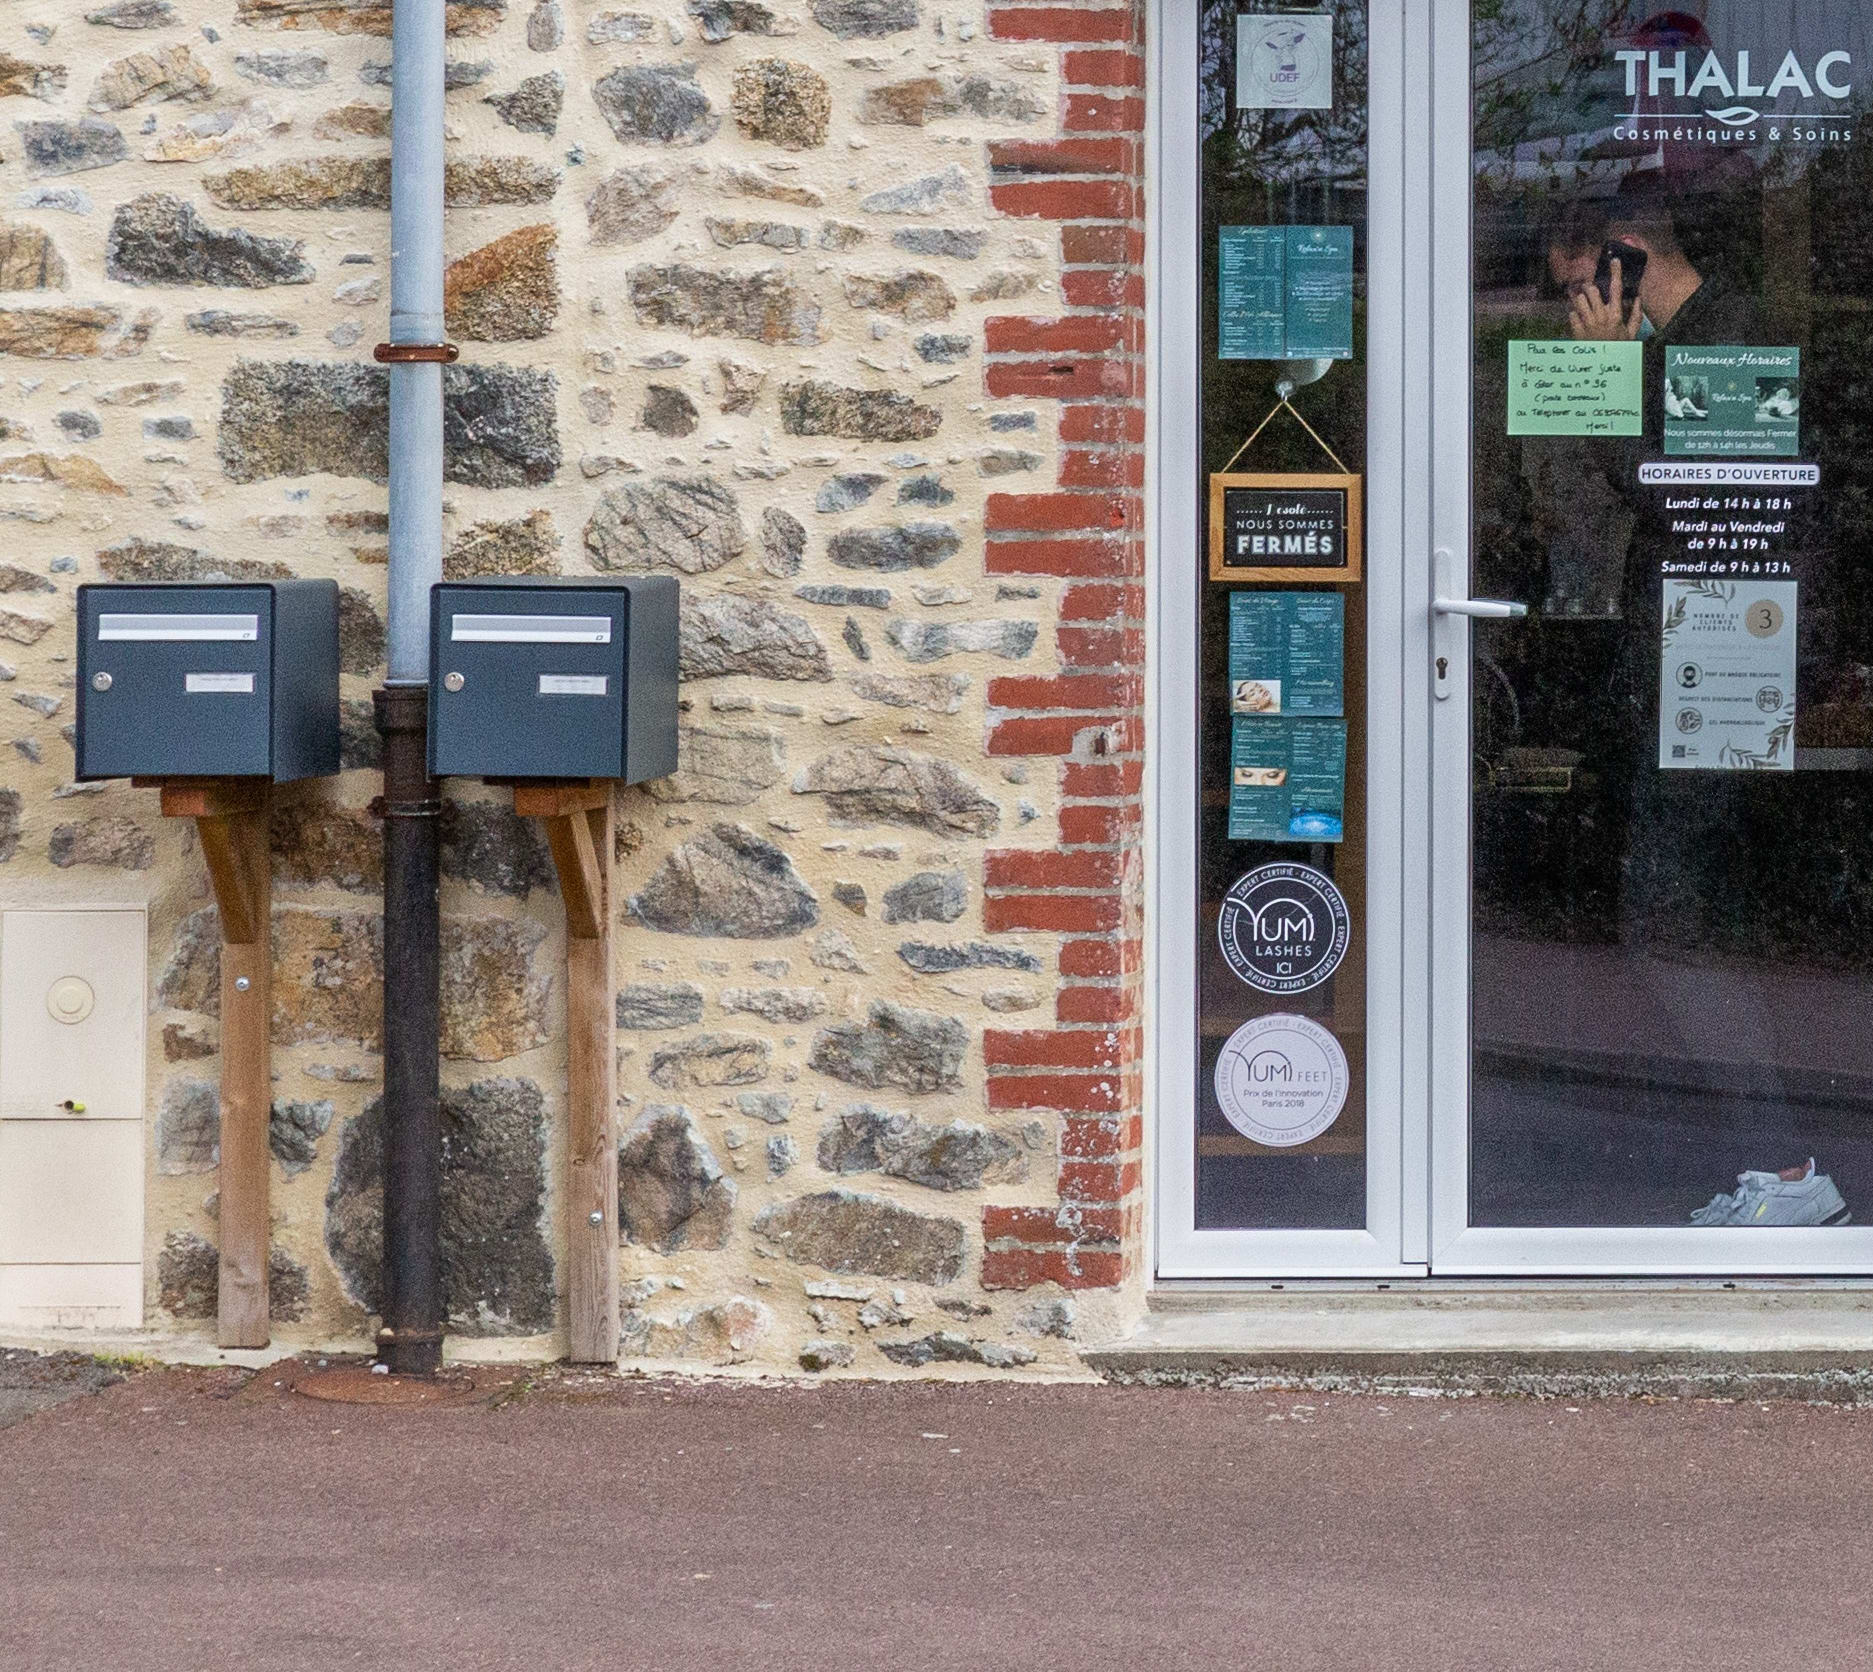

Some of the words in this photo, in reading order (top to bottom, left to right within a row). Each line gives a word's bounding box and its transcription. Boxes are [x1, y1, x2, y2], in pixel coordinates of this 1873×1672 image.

[1270, 72, 1300, 83] UDEF
[1614, 50, 1851, 98] THALAC
[1614, 126, 1757, 145] Cosmétiques
[1769, 128, 1780, 141] &
[1793, 126, 1852, 141] Soins
[1642, 468, 1711, 480] HORAIRES
[1717, 468, 1816, 481] D'OUVERTURE
[1666, 498, 1700, 509] Lundi
[1702, 498, 1719, 509] de
[1723, 499, 1739, 509] 14
[1741, 498, 1749, 509] h
[1752, 498, 1760, 509] à
[1765, 499, 1780, 509] 18
[1783, 498, 1791, 509] h
[1237, 520, 1272, 529] NOUS
[1279, 520, 1333, 529] SOMMES
[1671, 521, 1709, 533] Mardi
[1710, 523, 1727, 533] au
[1729, 521, 1785, 533] Vendredi
[1237, 531, 1333, 554] FERMÉS
[1687, 538, 1705, 550] de
[1707, 538, 1716, 550] 9
[1718, 538, 1727, 550] h
[1730, 538, 1738, 550] à
[1742, 538, 1758, 550] 19
[1760, 538, 1769, 550] h
[1661, 561, 1708, 573] Samedi
[1710, 561, 1727, 573] de
[1729, 561, 1739, 573] 9
[1741, 561, 1750, 573] h
[1752, 561, 1760, 573] à
[1764, 561, 1780, 573] 13
[1782, 561, 1791, 573] h
[1759, 608, 1772, 629] 3
[1236, 876, 1259, 897] EXPERT
[1261, 868, 1293, 879] CERTIFIÉ
[1301, 871, 1325, 888] EXPERT
[1335, 926, 1345, 952] EXPERT
[1227, 898, 1315, 941] YUMI
[1256, 946, 1312, 957] LASHES
[1276, 962, 1291, 974] ICI
[1229, 1050, 1292, 1082] YUMI
[1298, 1071, 1328, 1082] FEET
[1243, 1089, 1259, 1097] Prix
[1262, 1089, 1273, 1097] de
[1285, 1100, 1305, 1108] 2018
